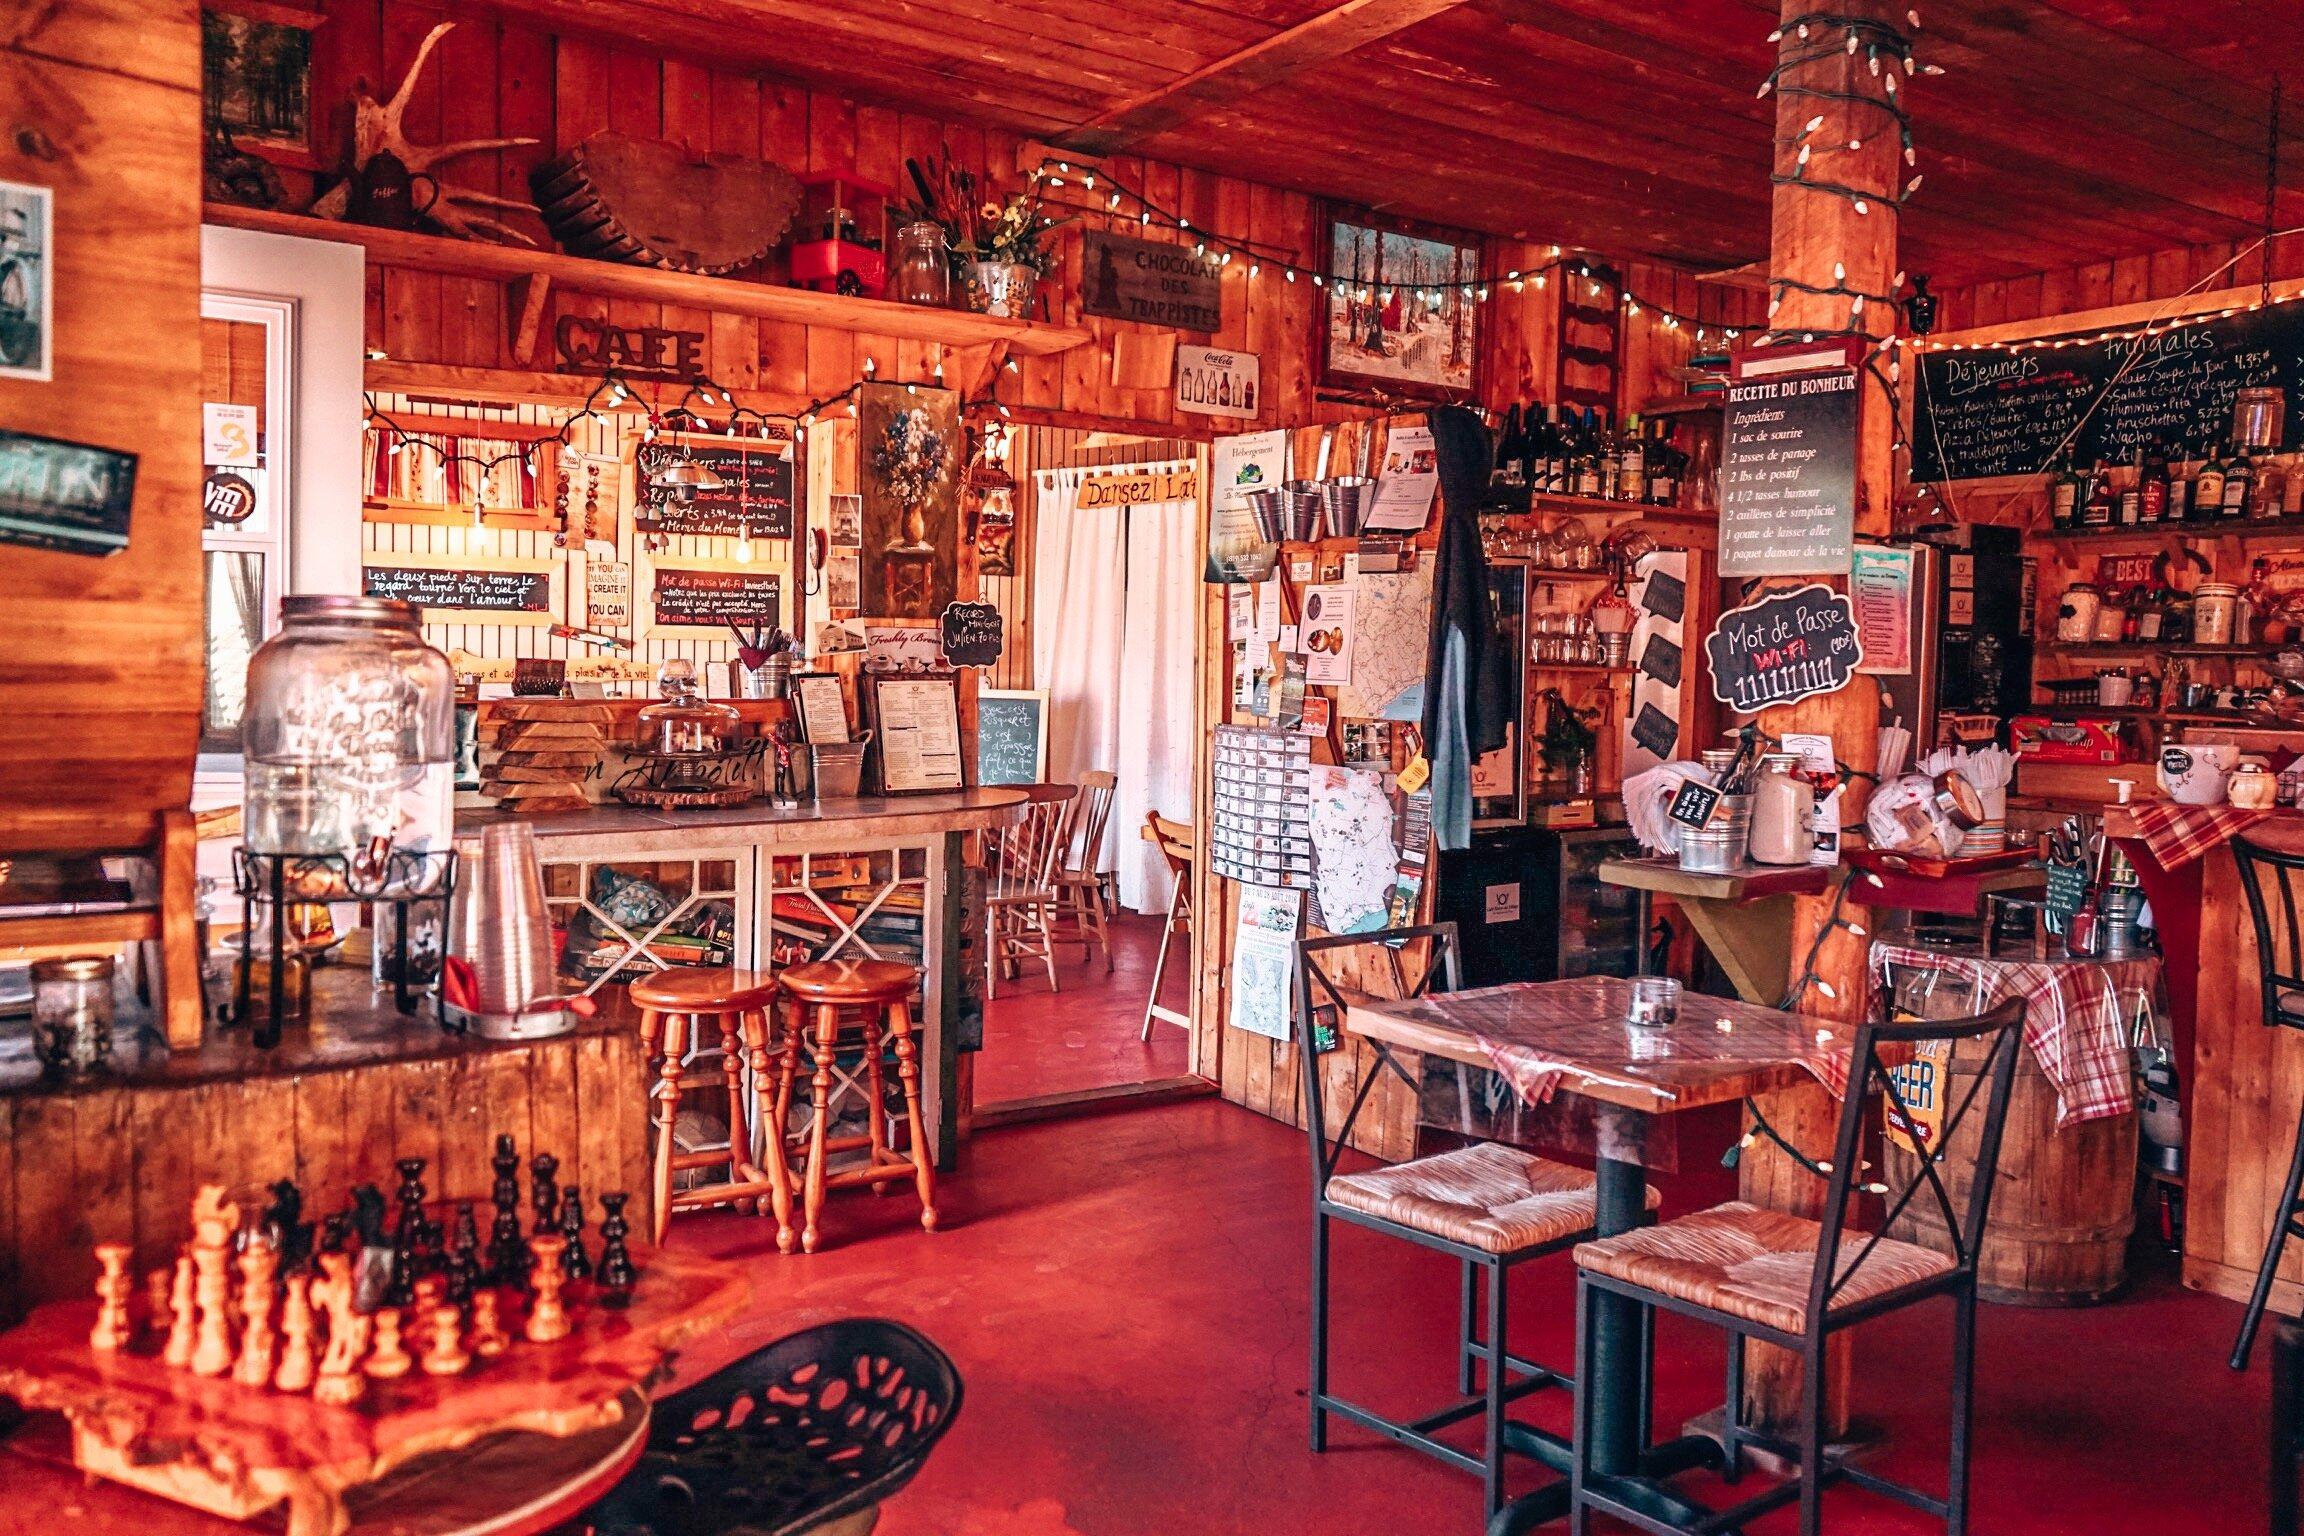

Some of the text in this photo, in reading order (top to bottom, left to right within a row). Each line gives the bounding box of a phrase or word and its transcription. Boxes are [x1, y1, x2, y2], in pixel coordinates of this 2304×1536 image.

[1136, 252, 1221, 278] CHOCOLAT
[1161, 280, 1189, 295] DES
[1130, 297, 1220, 326] TRAPPISTES
[556, 314, 705, 373] CAFE
[2104, 328, 2214, 360] Fringales
[1946, 356, 2039, 386] Déjeuners
[1730, 375, 1855, 402] RECETTE DU BONHEUR
[2112, 388, 2147, 403] Salade
[1734, 409, 1785, 428] Ingrédients
[1731, 428, 1803, 443] 1 sac de sourire
[2109, 431, 2153, 445] Nacho
[1232, 447, 1273, 458] Hébergement
[1730, 449, 1816, 463] 2 tasses de partage
[1729, 466, 1801, 482] 2 lbs de positif
[1087, 480, 1157, 506] Dansez!
[1166, 478, 1197, 499] Lai
[1728, 488, 1821, 503] 4 1/2 tasses humour
[1727, 504, 1836, 520] 2 cuillères de simplicité
[667, 520, 696, 532] Menu
[698, 520, 712, 533] du
[713, 521, 750, 535] Mome
[1726, 525, 1832, 542] 1 goutte de laisser aller
[1724, 549, 1730, 559] 1
[1732, 549, 1762, 561] paquet
[1803, 545, 1815, 556] de
[1819, 545, 1828, 555] la
[1831, 545, 1846, 556] vie
[598, 564, 613, 573] YOU
[2116, 559, 2151, 582] BEST
[368, 569, 386, 581] Les
[394, 569, 426, 583] deux
[429, 572, 457, 586] pieds
[588, 573, 619, 583] IMAGINE
[661, 575, 677, 587] Mot
[678, 576, 690, 587] de
[693, 578, 717, 589] passe
[374, 582, 413, 598] regard
[418, 580, 455, 592] tourné
[480, 583, 491, 593] le
[593, 584, 626, 594] CREATE IT
[686, 591, 698, 600] que
[436, 592, 463, 605] dans
[661, 598, 670, 607] Le
[671, 598, 694, 607] crédit
[711, 600, 722, 610] pas
[588, 603, 625, 615] YOU CAN
[954, 607, 985, 621] RECORD
[672, 614, 691, 623] aime
[695, 615, 714, 625] vous
[1729, 606, 1844, 655] Mot de Passe
[869, 630, 941, 649] Freshly Brew
[624, 667, 632, 678] la
[604, 959, 653, 971] HUMN
[1891, 1060, 1936, 1112] EER
